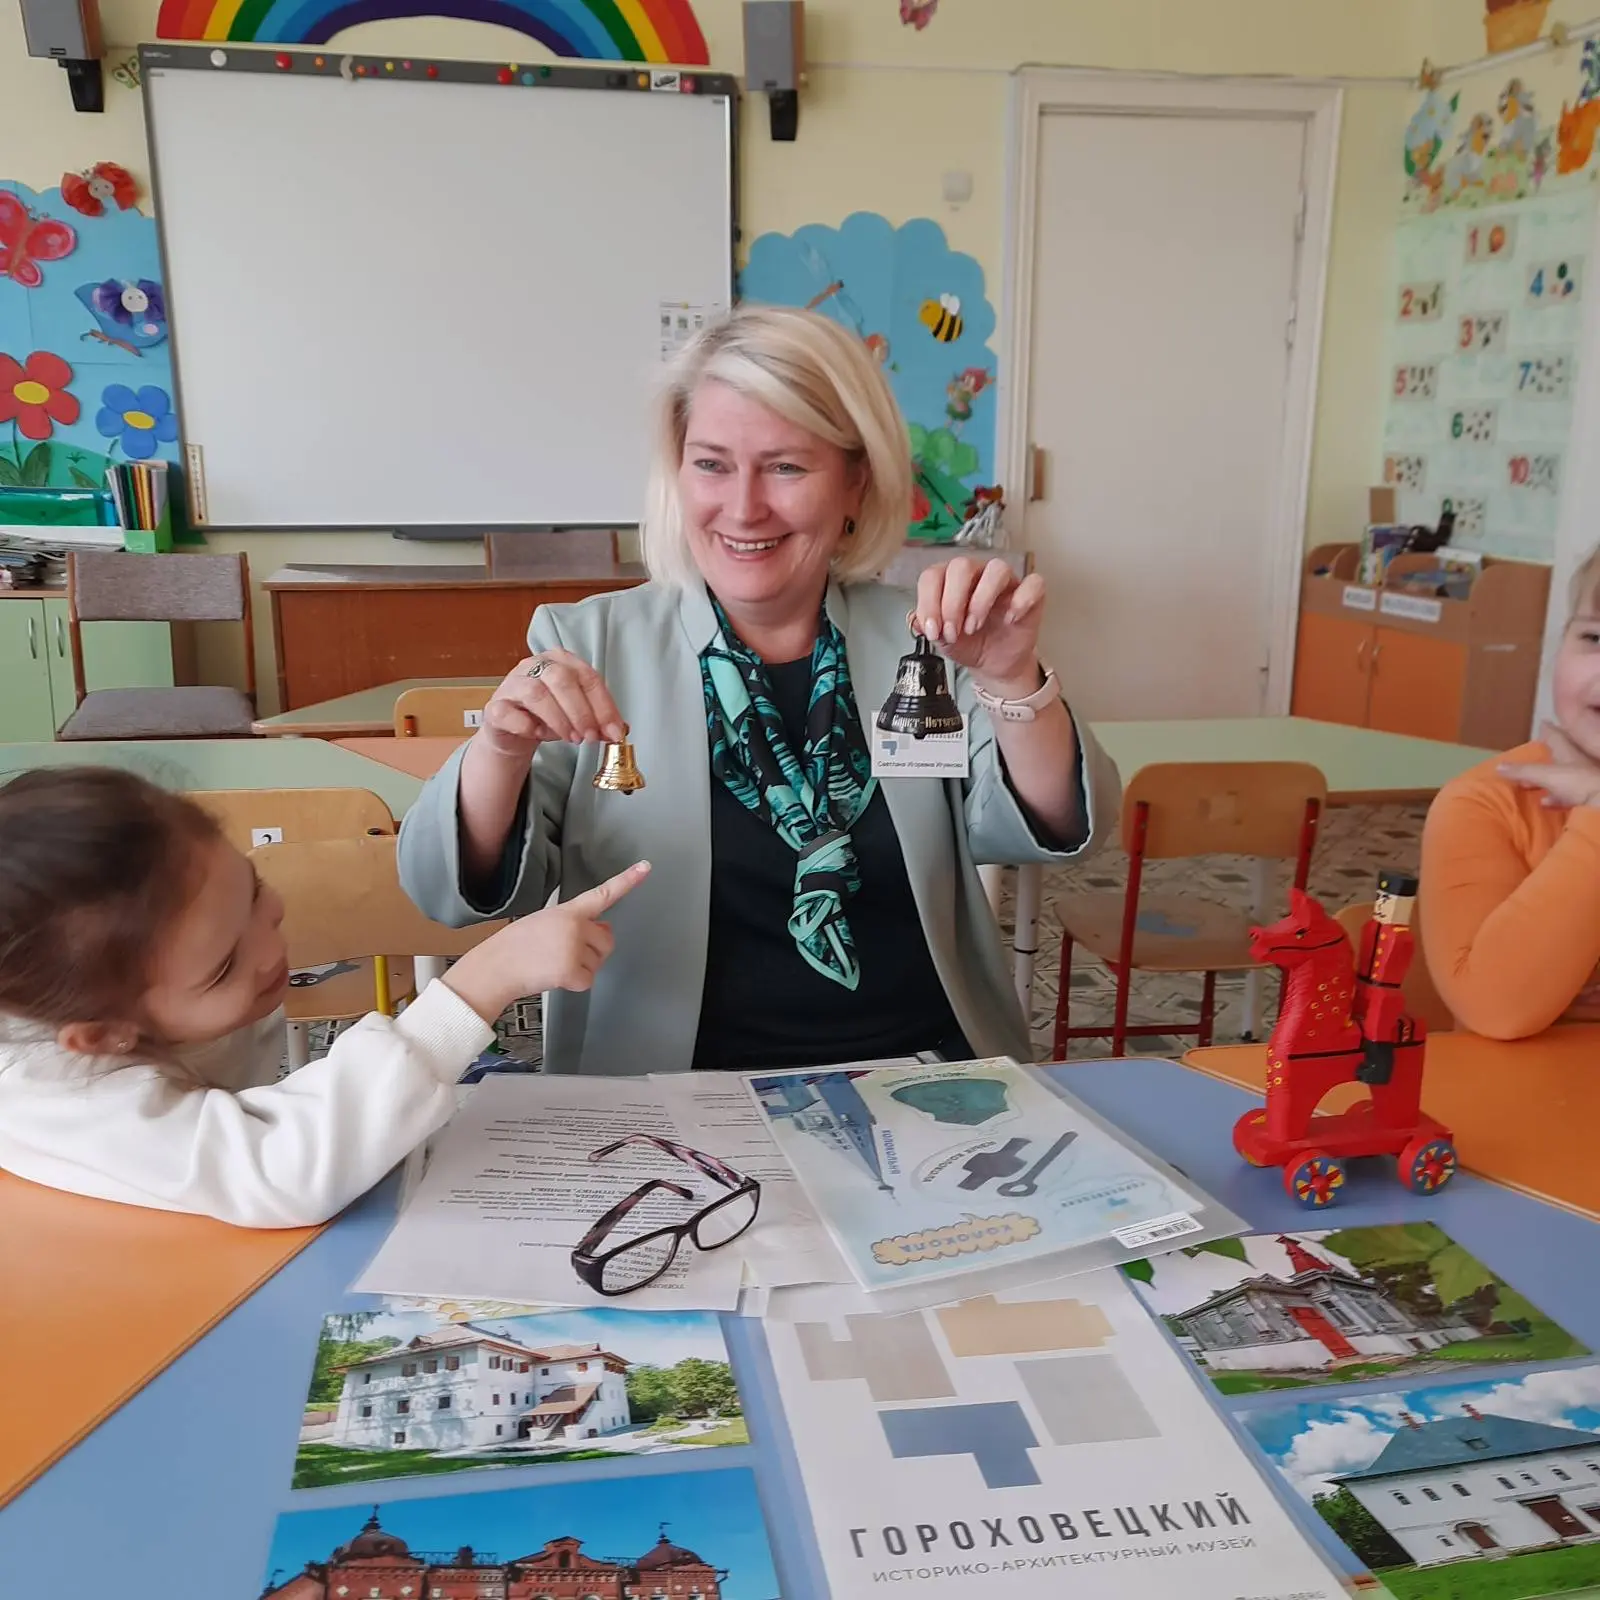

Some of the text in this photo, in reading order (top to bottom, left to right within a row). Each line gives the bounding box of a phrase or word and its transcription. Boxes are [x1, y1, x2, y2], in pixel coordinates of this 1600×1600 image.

[1468, 228, 1479, 255] 1
[1529, 269, 1544, 297] 4
[1400, 288, 1414, 317] 2
[1460, 318, 1474, 348] 3
[1394, 367, 1407, 396] 5
[1518, 360, 1533, 390] 7
[1451, 411, 1464, 439] 6
[1508, 455, 1531, 485] 10
[899, 1224, 1013, 1253] КОЛОКОЛА
[849, 1491, 1252, 1558] ГОРОХОВЕЦКИЙ
[873, 1535, 1258, 1584] ИСТОРИКО-АРХИТЕКТУРНЫЙ МУЗЕЙ
